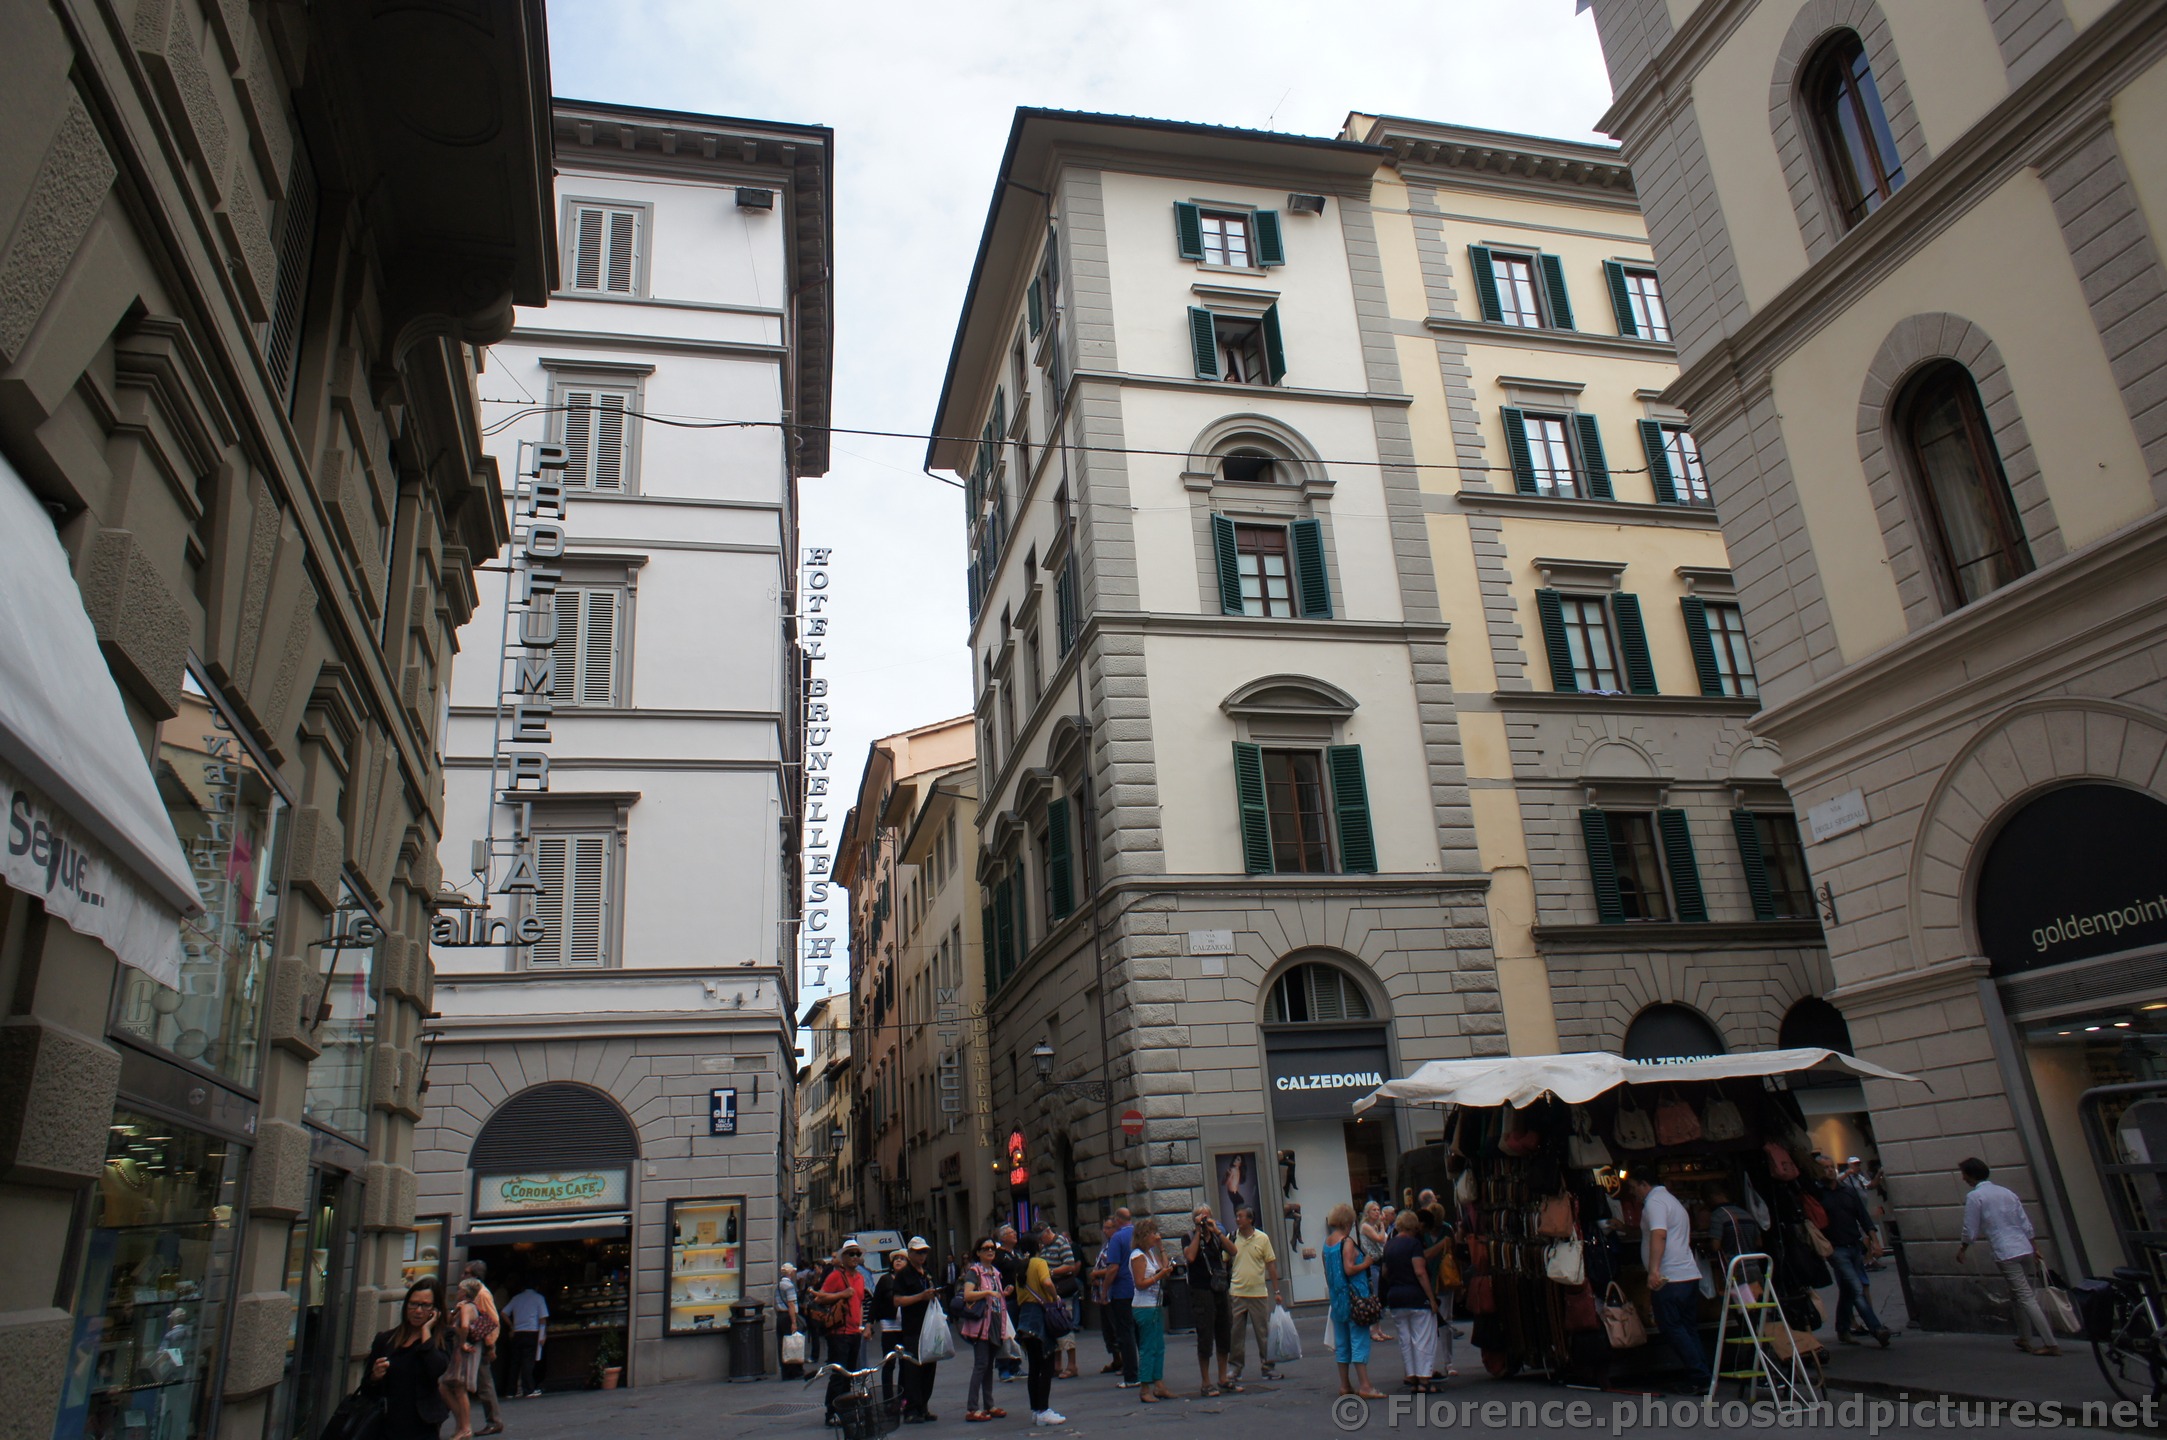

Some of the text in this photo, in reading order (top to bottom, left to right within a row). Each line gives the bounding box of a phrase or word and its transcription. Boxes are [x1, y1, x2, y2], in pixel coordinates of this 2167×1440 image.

[500, 441, 570, 894] PROFUMERIA
[806, 547, 835, 987] HOTEL BRUNELLESCHI
[430, 910, 545, 947] aline
[2032, 894, 2167, 952] goldenpoint
[970, 1001, 989, 1147] GELATERIA
[1276, 1071, 1384, 1091] CALZEDONIA
[714, 1089, 735, 1118] T
[511, 1184, 563, 1198] CORONAS
[879, 1237, 892, 1245] GLS
